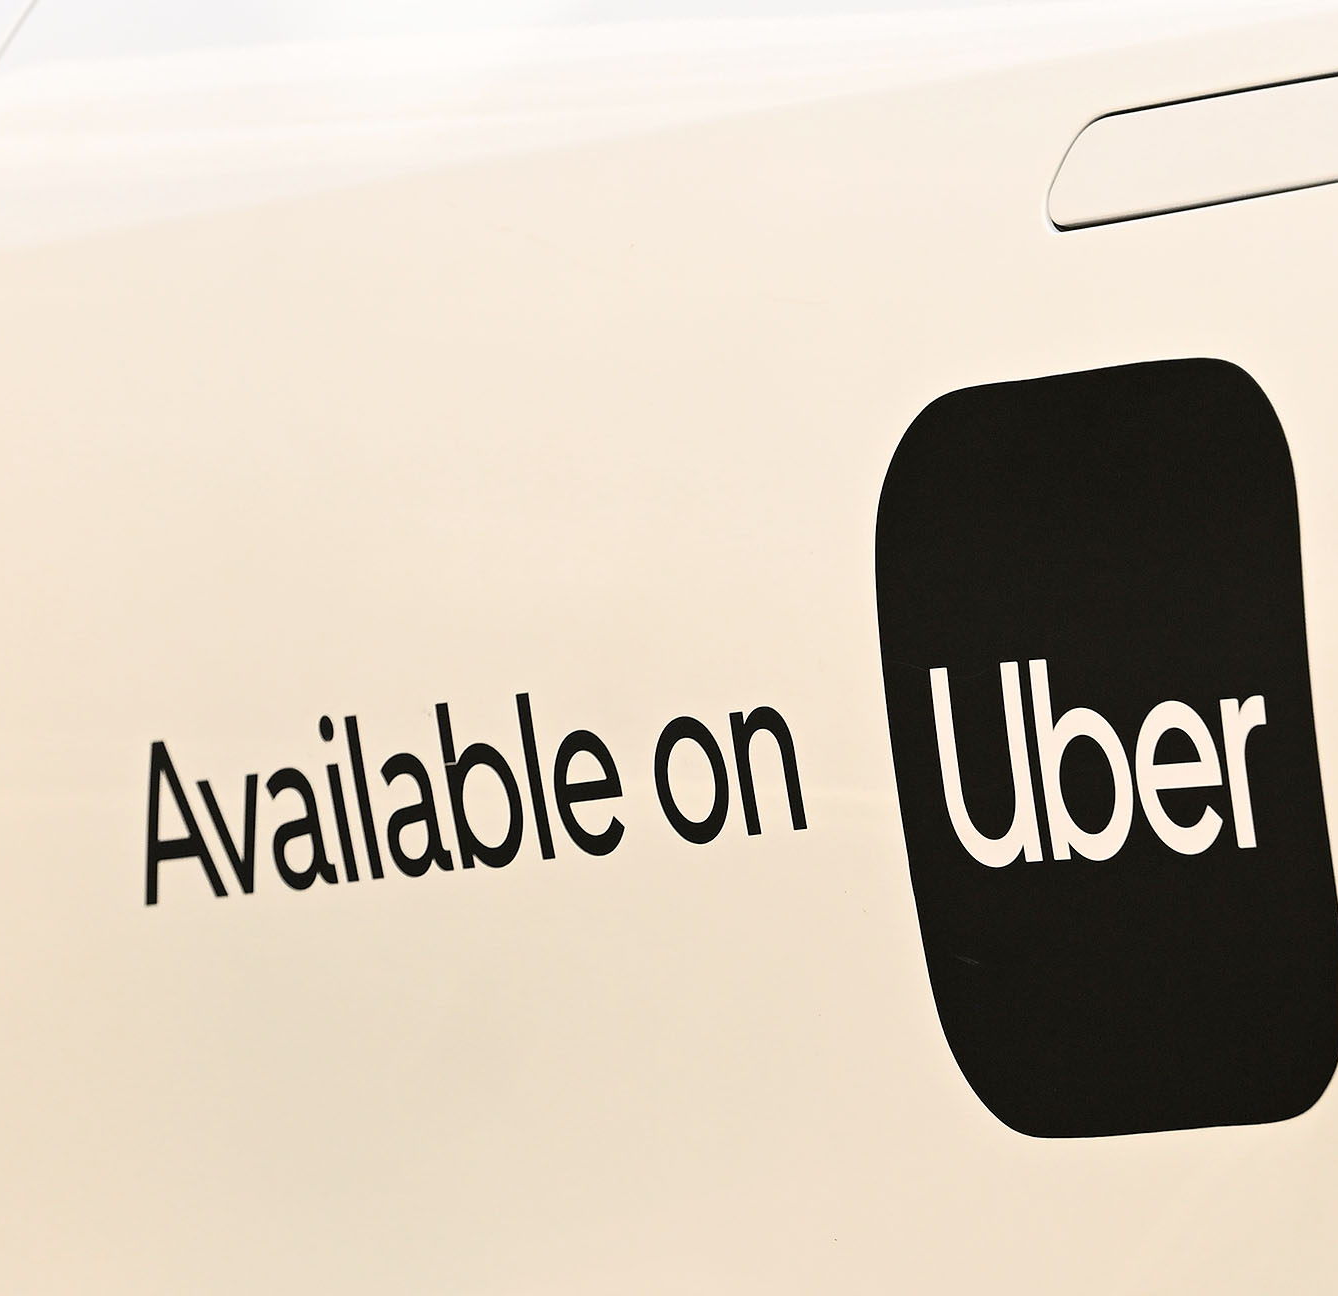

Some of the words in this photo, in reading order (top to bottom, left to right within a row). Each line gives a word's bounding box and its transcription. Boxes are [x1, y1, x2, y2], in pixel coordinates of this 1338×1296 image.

[144, 691, 626, 907] Available
[653, 705, 809, 846] on
[928, 657, 1268, 869] Uber
